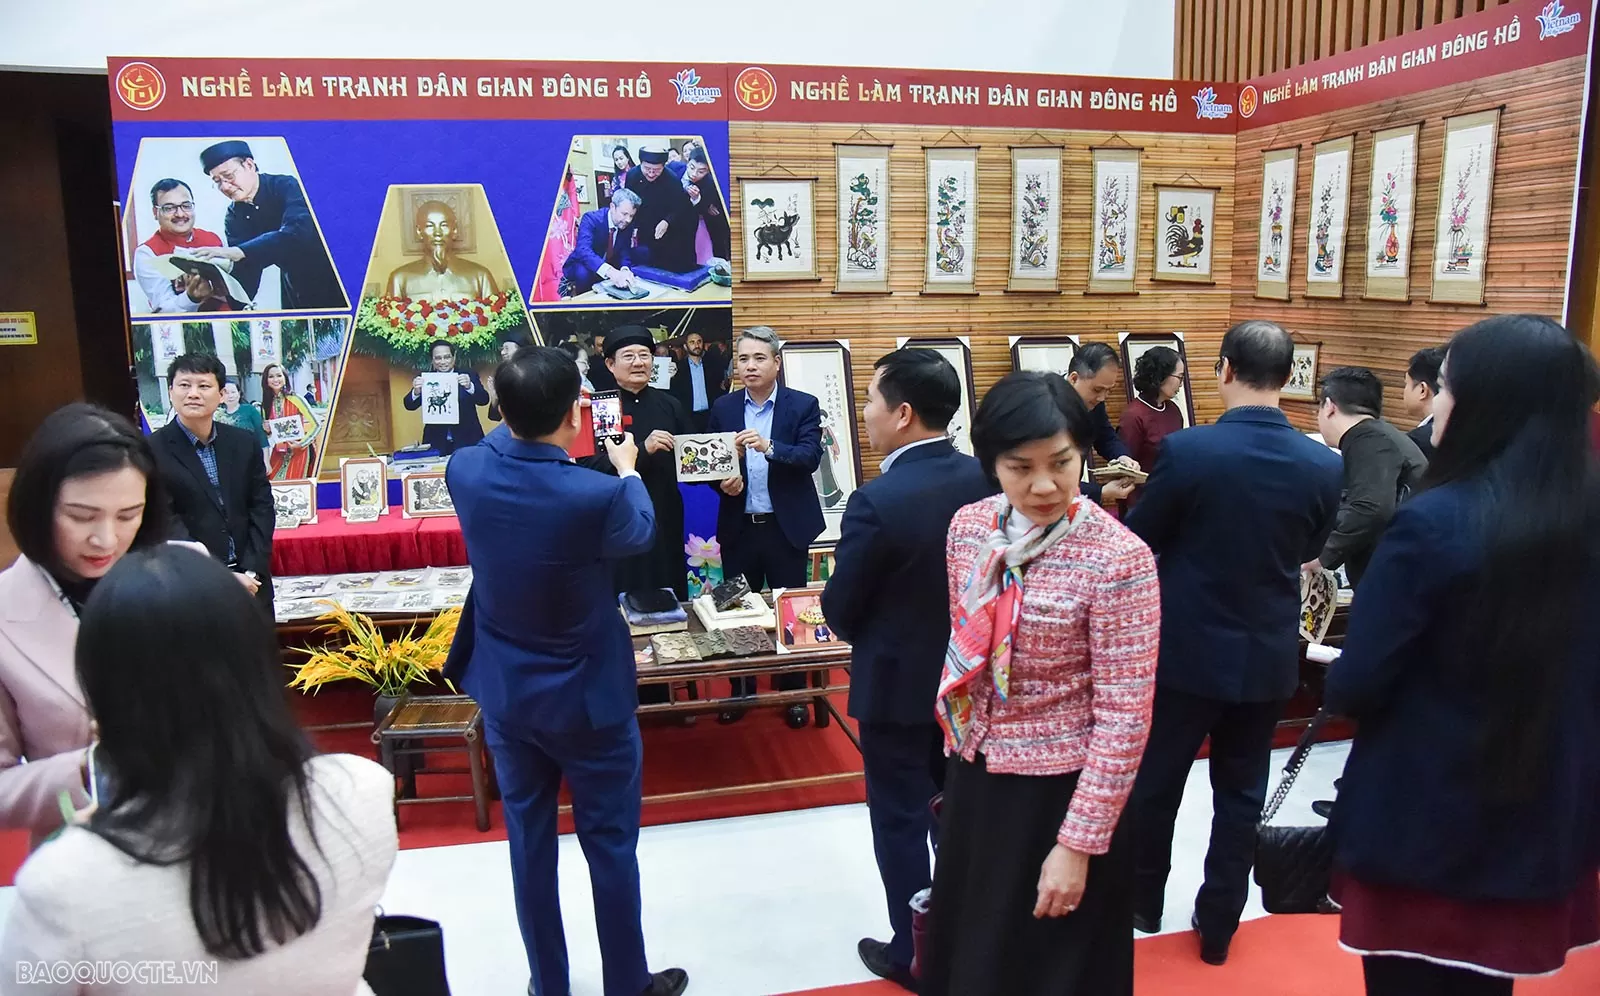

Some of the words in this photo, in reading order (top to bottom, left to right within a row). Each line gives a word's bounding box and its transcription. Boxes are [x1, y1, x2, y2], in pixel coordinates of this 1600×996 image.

[1535, 13, 1581, 40] Vietnam
[1263, 79, 1291, 105] NGHỀ
[1295, 77, 1318, 97] LÀM
[1322, 65, 1364, 90] TRANH
[1368, 56, 1396, 79] DÂN
[1401, 45, 1436, 70] GIAN
[1441, 34, 1488, 60] ĐÔNG
[1493, 15, 1521, 46] HỒ
[181, 68, 253, 97] NGHỀ
[262, 72, 314, 97] LÀM
[322, 76, 408, 98] TRANH
[417, 72, 467, 97] DÂN
[477, 76, 534, 97] GIAN
[542, 73, 608, 97] ĐÔNG
[616, 71, 652, 98] HỒ
[669, 79, 721, 104] Vietnam
[790, 75, 850, 101] NGHỀ
[858, 79, 902, 102] LÀM
[909, 84, 980, 106] TRANH
[988, 84, 1029, 107] DÂN
[1037, 89, 1083, 108] GIAN
[1090, 88, 1143, 111] ĐÔNG
[1150, 87, 1178, 113] HỒ
[1191, 95, 1232, 119] Vietnam
